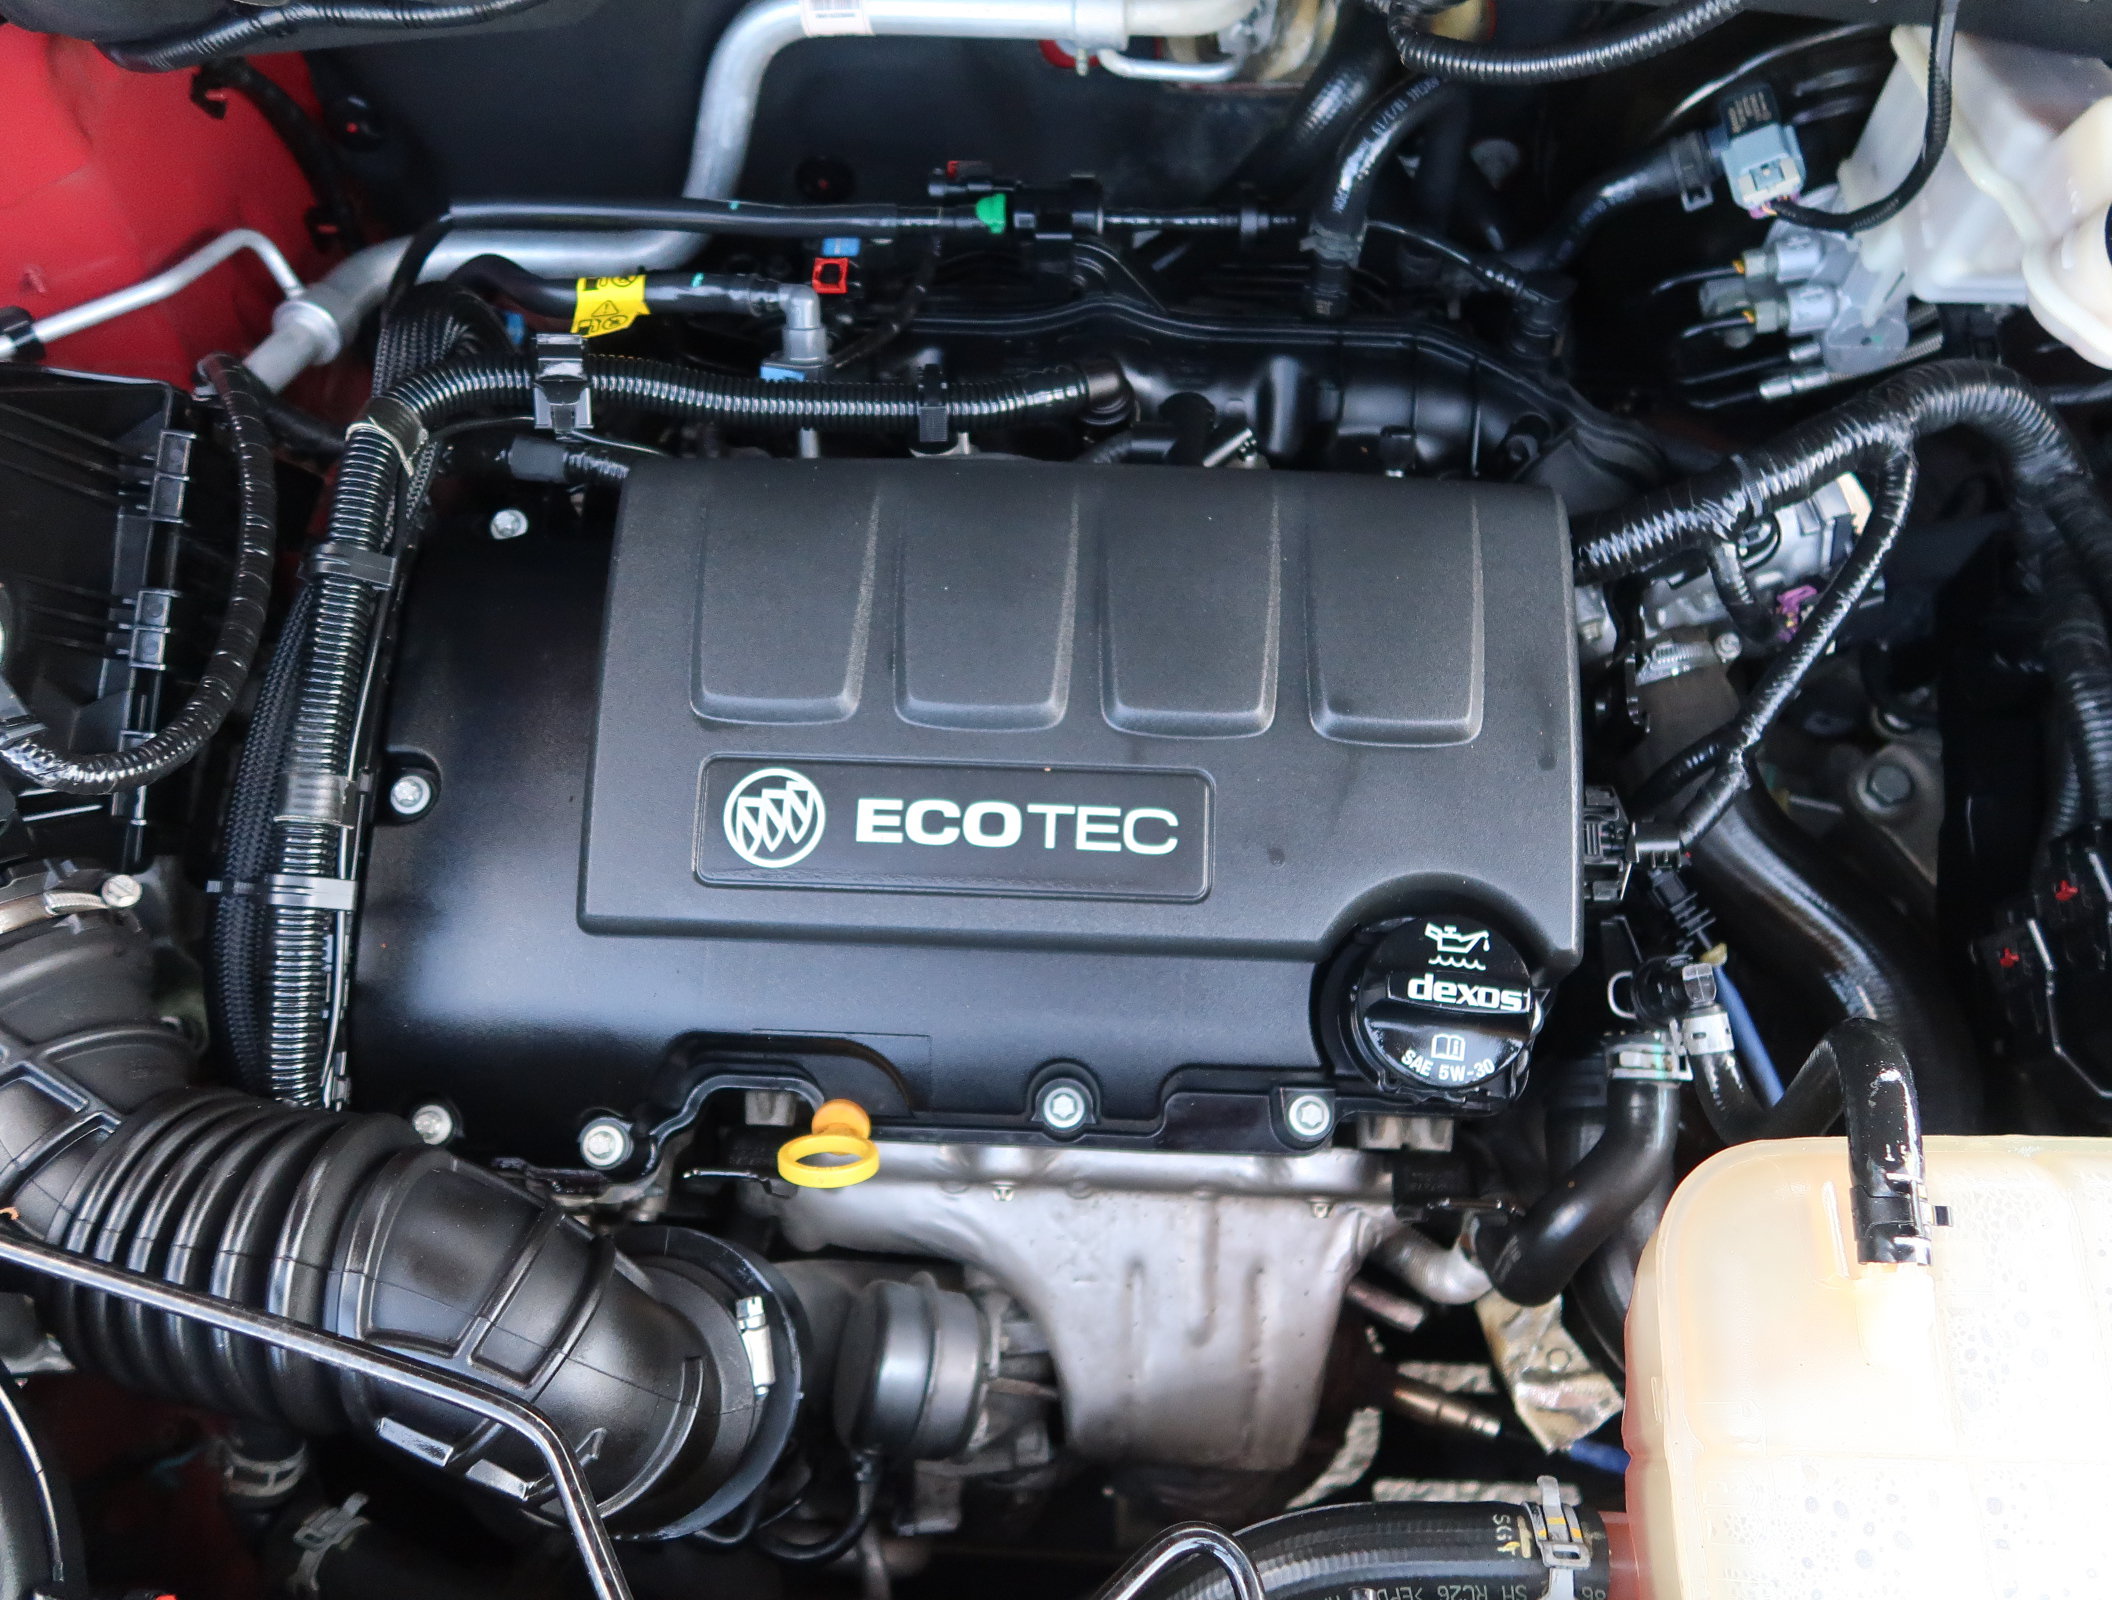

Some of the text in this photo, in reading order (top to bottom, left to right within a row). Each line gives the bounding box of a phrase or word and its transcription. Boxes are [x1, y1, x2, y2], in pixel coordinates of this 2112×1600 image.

[855, 797, 1179, 855] ECOTEC
[1401, 1049, 1496, 1082] SAE 5W-30
